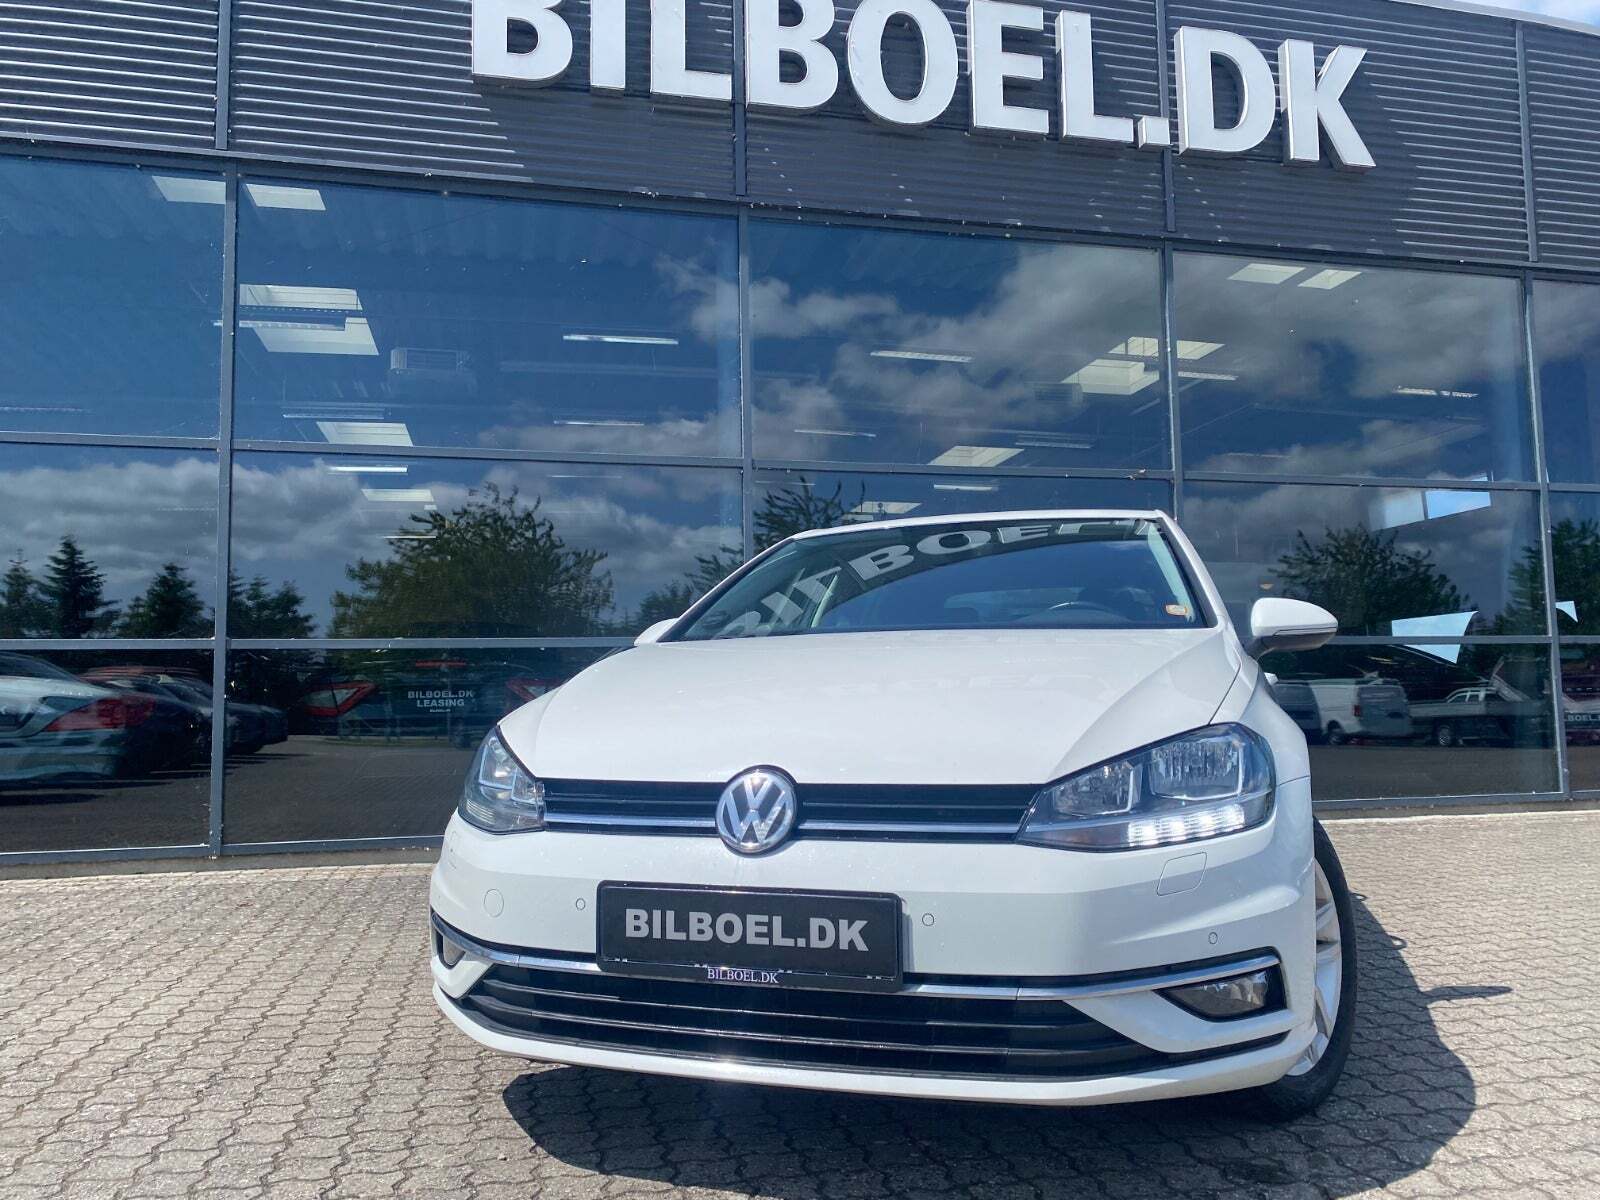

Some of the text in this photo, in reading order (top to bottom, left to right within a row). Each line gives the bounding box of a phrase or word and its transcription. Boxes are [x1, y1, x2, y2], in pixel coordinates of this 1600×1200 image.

[417, 699, 465, 707] LEASING
[625, 908, 869, 952] BILBOEL.DK
[707, 968, 779, 984] BILBOEL.DK
